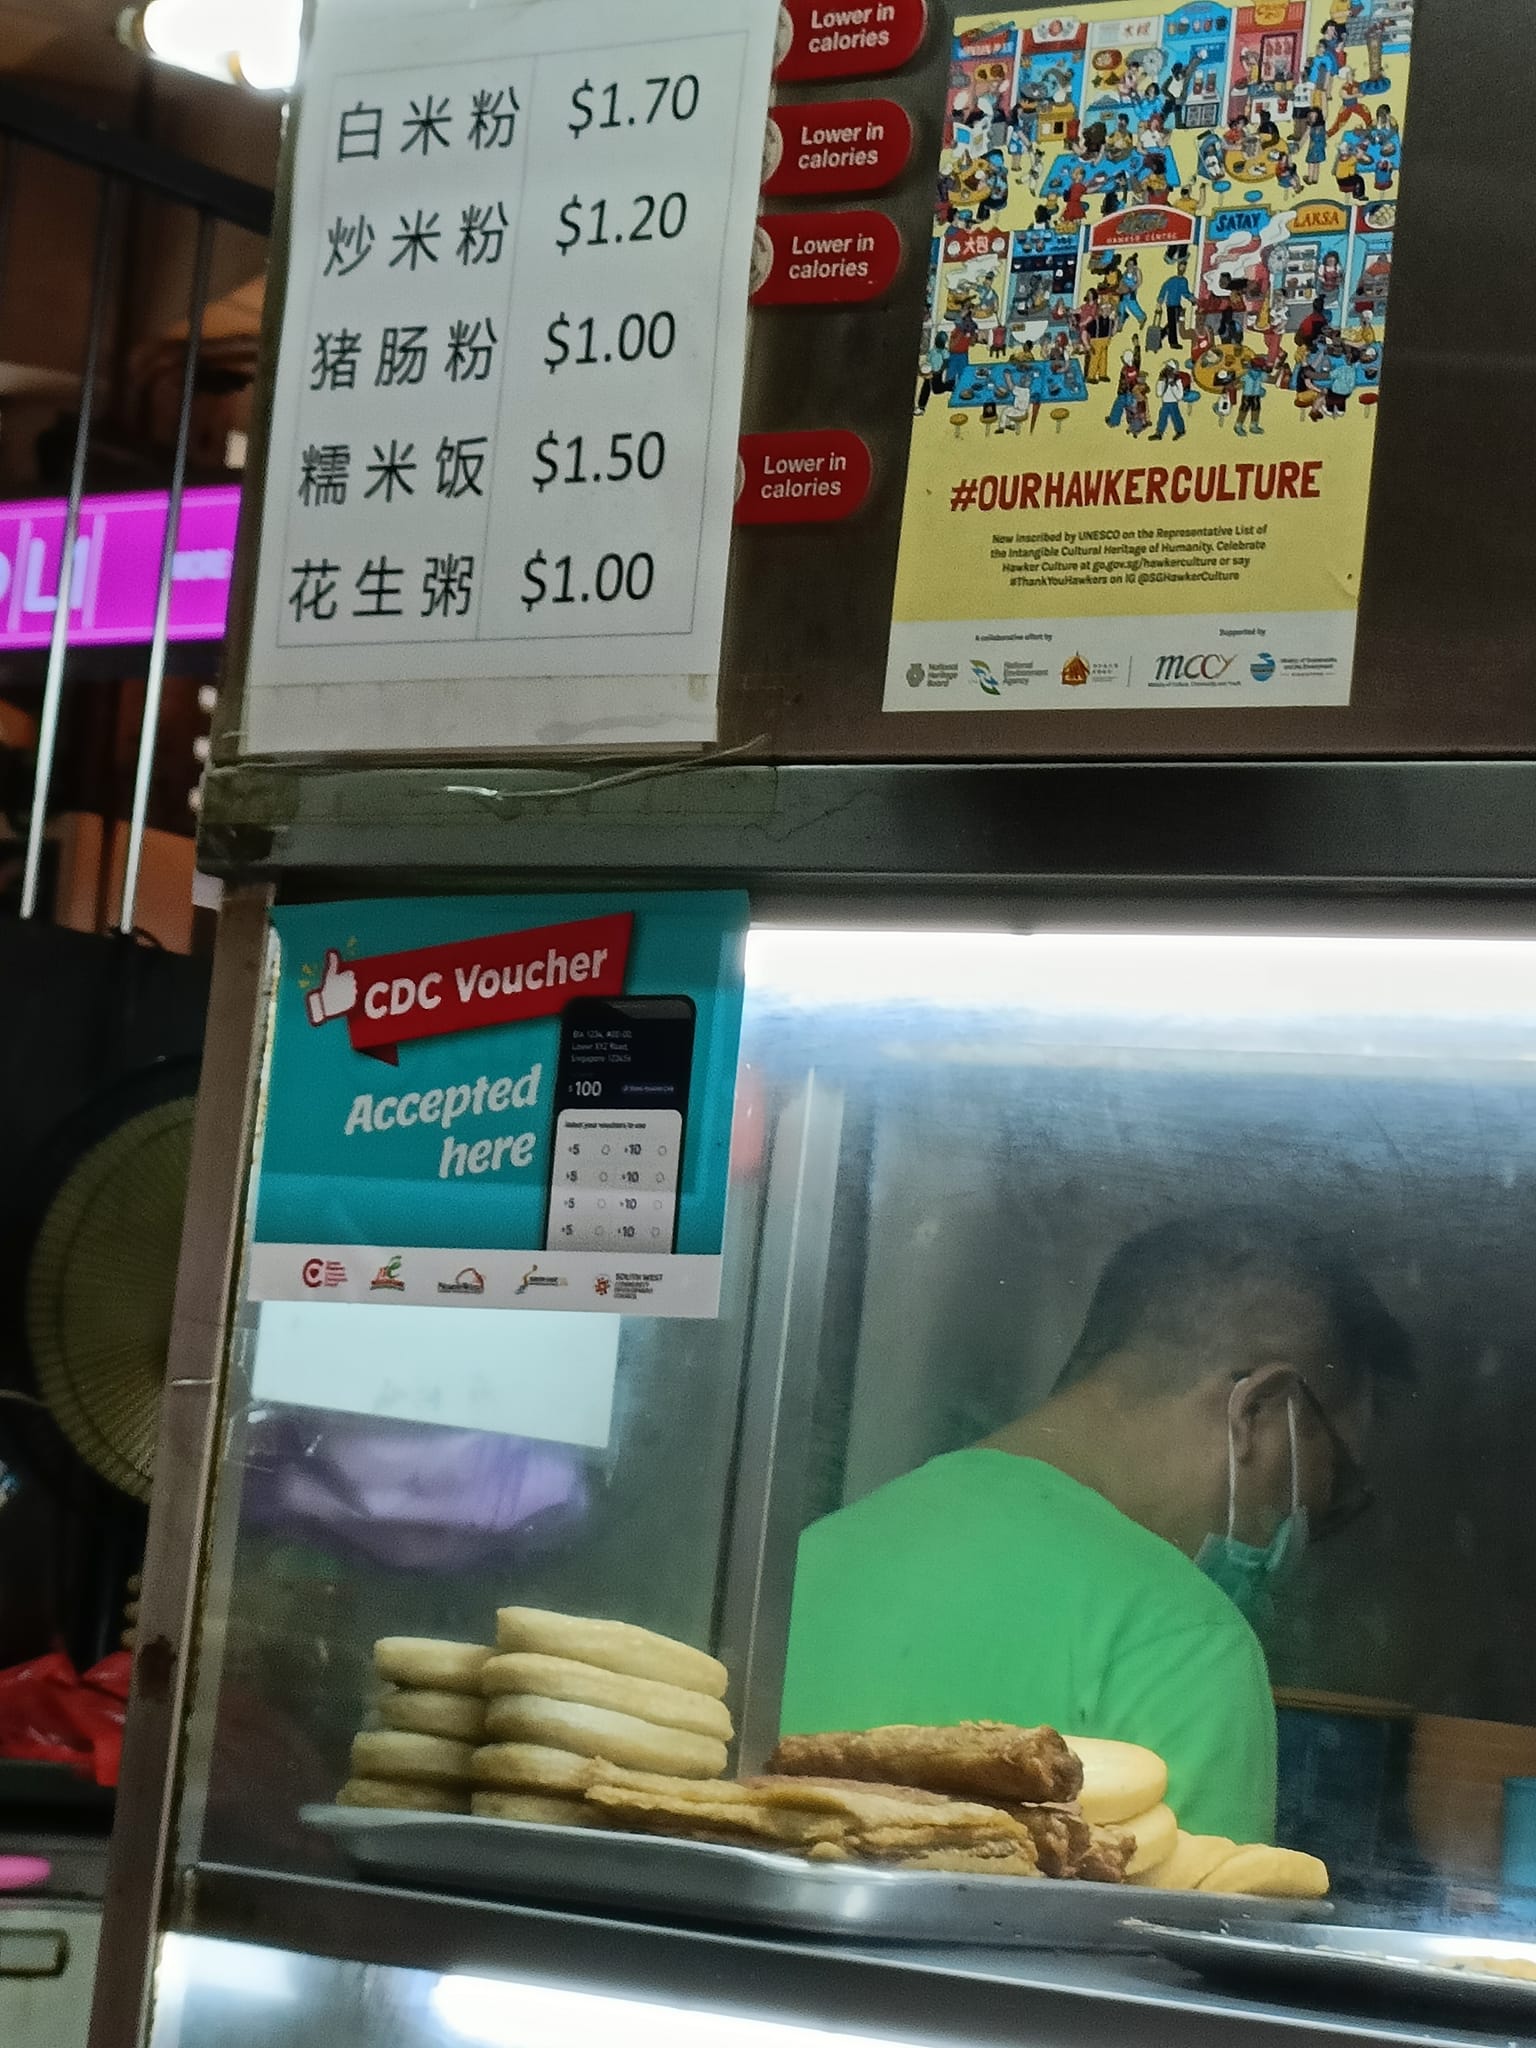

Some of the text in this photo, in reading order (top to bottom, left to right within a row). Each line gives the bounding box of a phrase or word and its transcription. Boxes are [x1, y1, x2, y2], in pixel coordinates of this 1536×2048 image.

[811, 3, 896, 29] Lower in
[808, 28, 890, 53] calories
[337, 85, 521, 163] 白米粉
[568, 74, 701, 139] $1.70
[801, 122, 885, 146] Lower in
[798, 147, 879, 170] calories
[323, 201, 509, 277] 炒米粉
[555, 191, 688, 257] $1.20
[791, 233, 875, 255] Lower in
[1215, 212, 1261, 233] SATAY
[789, 258, 869, 280] calories
[309, 317, 499, 391] 猪肠粉
[544, 311, 676, 374] $1.00
[299, 436, 488, 507] 糯米饭
[532, 430, 666, 493] $1.50
[763, 452, 847, 475] Lower in
[760, 477, 842, 499] calories
[950, 461, 1323, 512] #OURHAWKERCULTURE
[990, 548, 1007, 559] the
[1061, 545, 1102, 557] Cultural
[1104, 543, 1147, 557] Heritage
[1149, 542, 1159, 553] of
[1216, 539, 1267, 551] Celebrate
[1064, 531, 1077, 544] by
[1078, 529, 1121, 541] UNESCO
[1122, 530, 1135, 540] on
[1137, 528, 1154, 539] the
[1156, 525, 1233, 540] Representative
[1235, 524, 1254, 536] List
[1256, 523, 1268, 534] of
[288, 552, 474, 623] 花生粥
[520, 548, 655, 612] $1.00
[1002, 562, 1040, 573] Hawker
[1041, 561, 1079, 572] Culture
[1080, 560, 1091, 571] at
[1219, 556, 1230, 566] or
[1232, 556, 1251, 569] say
[1109, 574, 1123, 585] on
[364, 948, 608, 1020] CDC Voucher
[344, 1063, 542, 1136] Accepted
[439, 1132, 537, 1179] here
